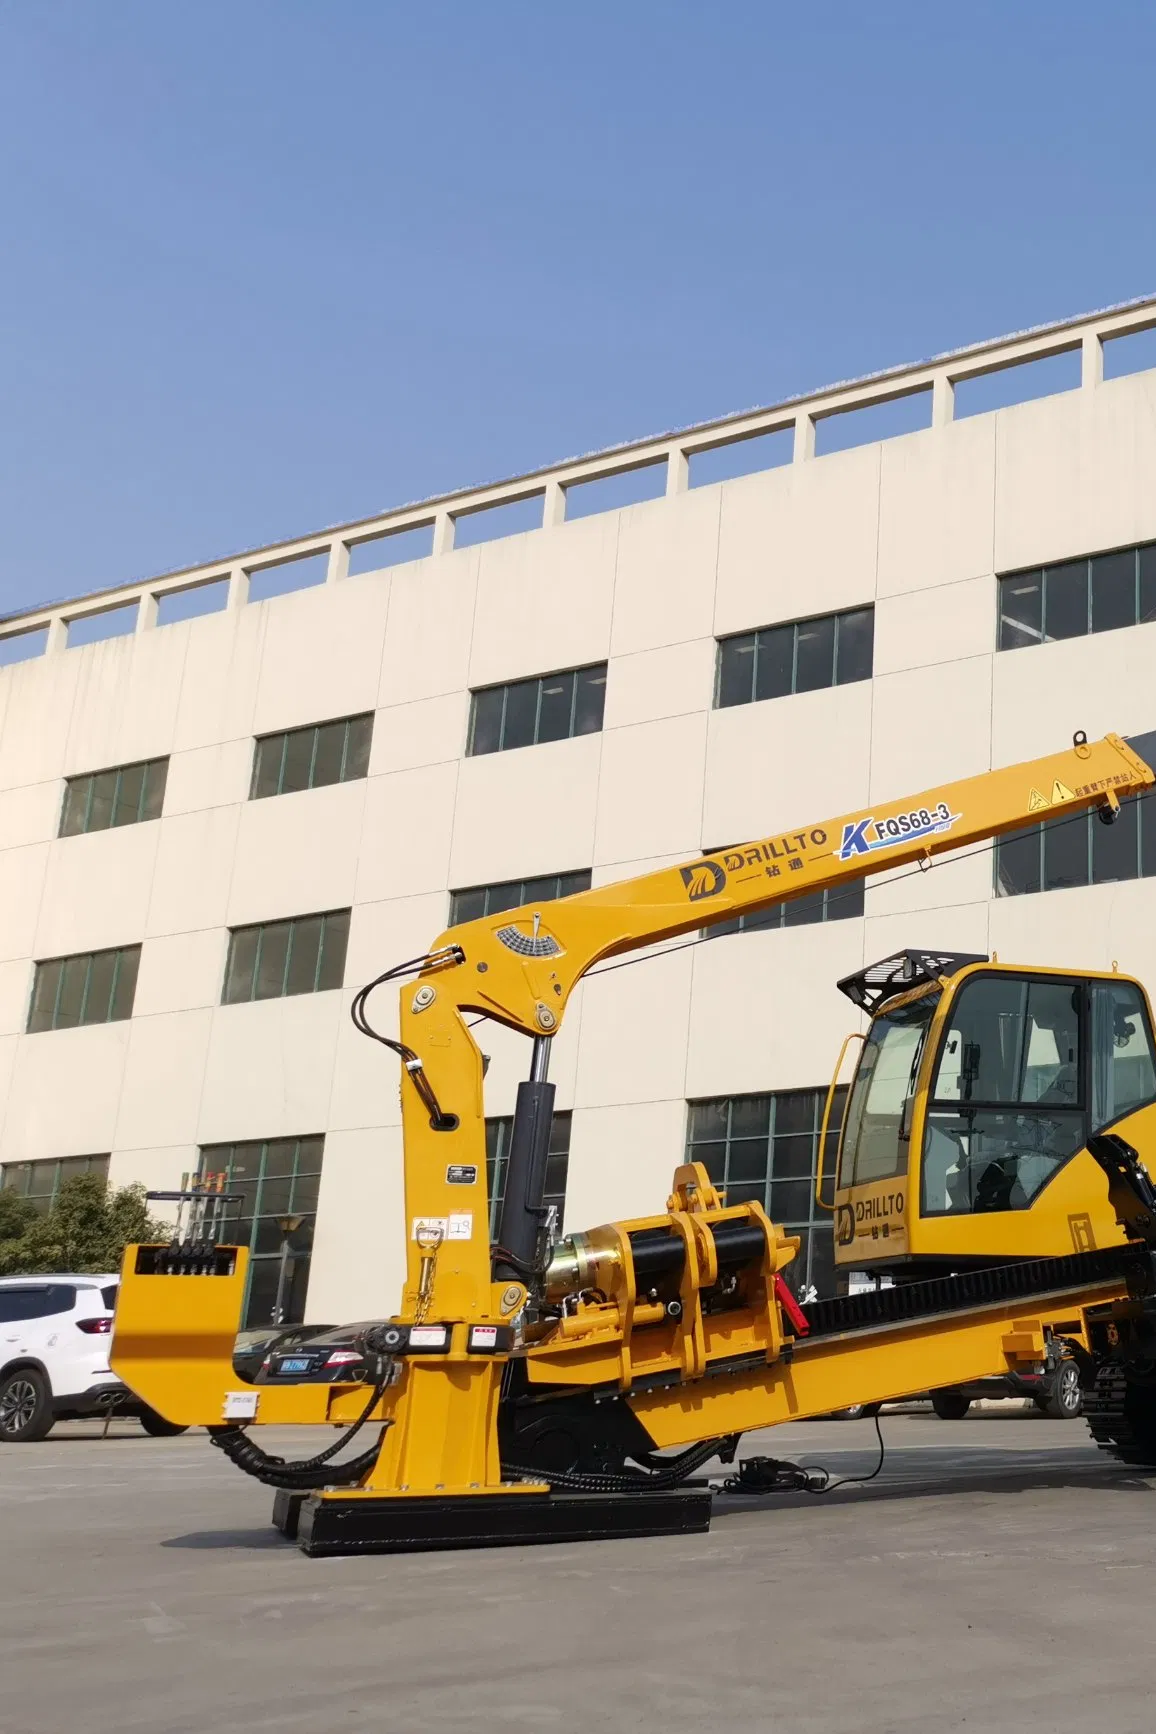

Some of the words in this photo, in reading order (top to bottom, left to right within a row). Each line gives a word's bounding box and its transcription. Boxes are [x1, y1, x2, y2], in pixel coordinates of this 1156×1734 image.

[875, 804, 950, 840] FQS68-3
[724, 829, 827, 872] DRILLTO
[765, 857, 803, 878] 钻通
[856, 1192, 904, 1221] DRILLTO
